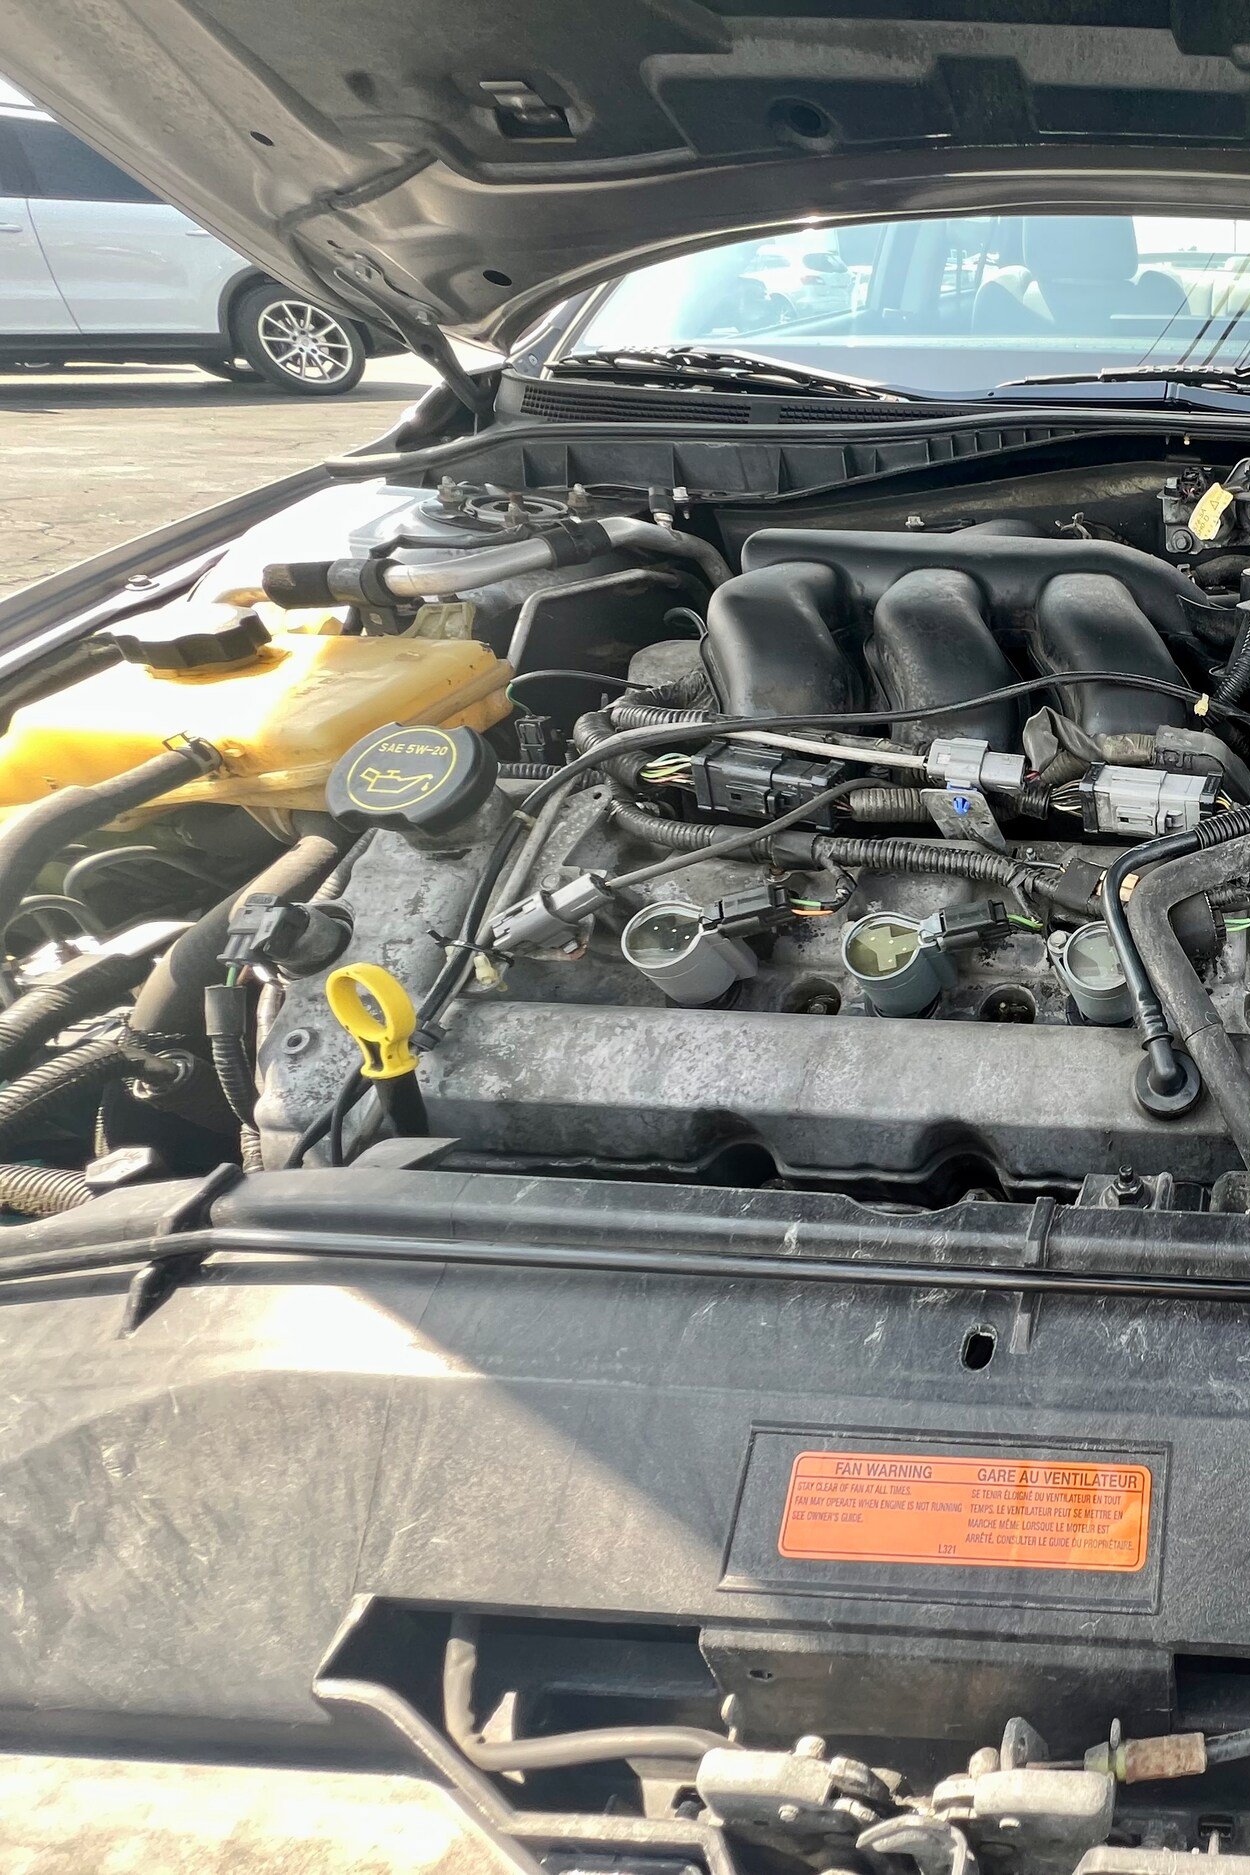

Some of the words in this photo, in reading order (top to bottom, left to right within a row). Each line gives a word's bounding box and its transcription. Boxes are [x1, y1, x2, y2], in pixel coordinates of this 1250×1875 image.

[378, 743, 405, 753] SAE
[405, 744, 448, 756] 5W-20
[835, 1461, 862, 1476] FAN
[866, 1463, 933, 1479] WARNING
[977, 1468, 1017, 1483] GARE
[1019, 1470, 1039, 1484] AU
[1043, 1471, 1138, 1489] VENTILATEUR
[797, 1481, 815, 1491] STAY
[815, 1482, 838, 1492] CLEAR
[839, 1482, 849, 1492] OF
[850, 1483, 864, 1493] FAN
[865, 1484, 874, 1494] AT
[874, 1484, 888, 1494] ALL
[794, 1495, 809, 1505] FAN
[809, 1496, 826, 1506] MAY
[826, 1497, 857, 1507] OPERATE
[858, 1499, 879, 1508] WHEN
[880, 1499, 906, 1510] ENGINE
[907, 1500, 914, 1510] IS
[915, 1501, 930, 1511] NOT
[971, 1488, 981, 1499] SE
[982, 1489, 1003, 1500] TENIR
[1034, 1491, 1045, 1501] DU
[1046, 1492, 1091, 1504] VENTILATEUR
[1093, 1494, 1103, 1504] EN
[1104, 1495, 1122, 1505] TOUT
[792, 1510, 806, 1520] SEE
[806, 1511, 839, 1522] OWNER'S
[996, 1504, 1005, 1515] LE
[1006, 1505, 1053, 1517] VENTILATEUR
[1053, 1507, 1072, 1518] PEUT
[1073, 1508, 1083, 1519] SE
[1084, 1509, 1112, 1520] METTRE
[1113, 1510, 1124, 1520] EN
[967, 1518, 997, 1529] MARCHE
[1022, 1520, 1055, 1532] LORSQUE
[1056, 1522, 1064, 1533] LE
[1066, 1523, 1096, 1534] MOTEUR
[1097, 1524, 1110, 1535] EST
[938, 1543, 957, 1555] L321
[996, 1534, 1037, 1546] CONSULTER
[1038, 1536, 1047, 1547] LE
[1048, 1537, 1070, 1548] GUIDE
[1071, 1537, 1082, 1548] DU
